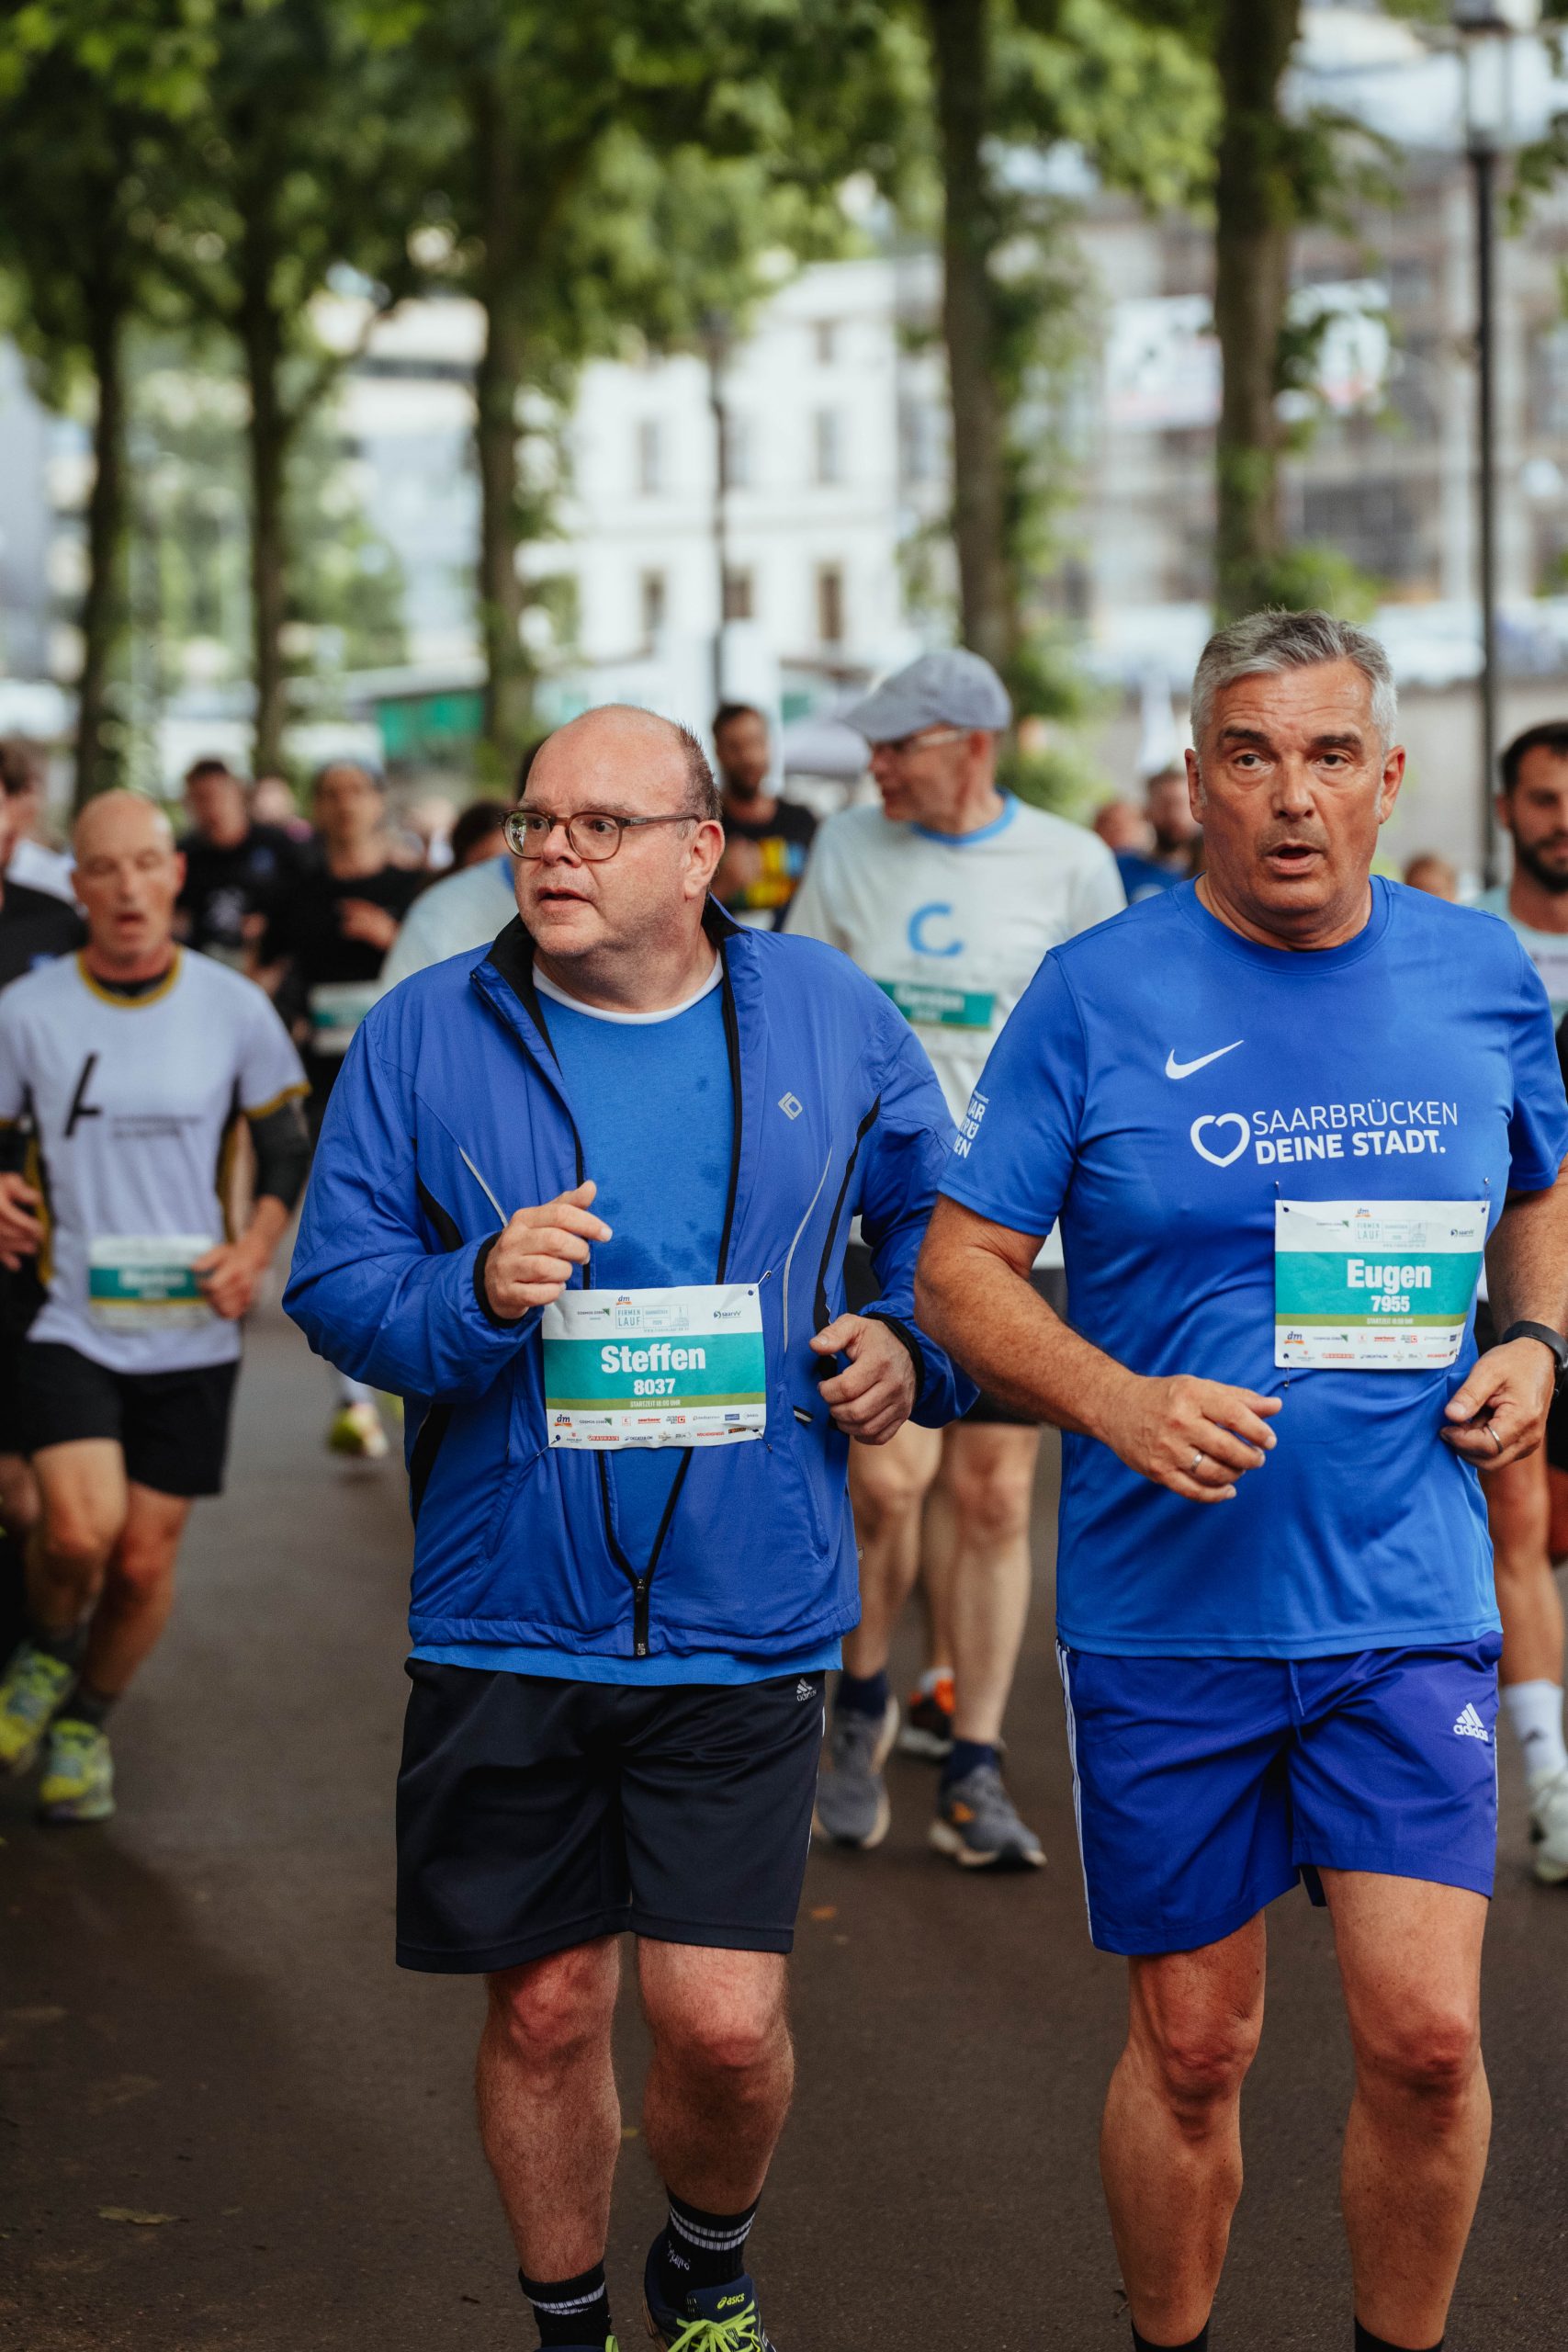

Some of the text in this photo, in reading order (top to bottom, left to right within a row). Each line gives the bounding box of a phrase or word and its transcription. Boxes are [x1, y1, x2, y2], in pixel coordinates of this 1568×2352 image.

[1252, 1098, 1458, 1136] SAARBRÜCKEN
[1255, 1129, 1447, 1165] DEINE STADT.
[1357, 1230, 1380, 1240] LAUF
[1347, 1259, 1432, 1295] Eugen
[617, 1308, 641, 1317] FIRMEN
[1371, 1295, 1410, 1313] 7955
[618, 1317, 641, 1327] LAUF
[1287, 1331, 1303, 1340] dm
[602, 1343, 706, 1374] Steffen
[634, 1378, 676, 1396] 8037
[557, 1414, 570, 1422] dm
[1453, 1724, 1489, 1742] adidas
